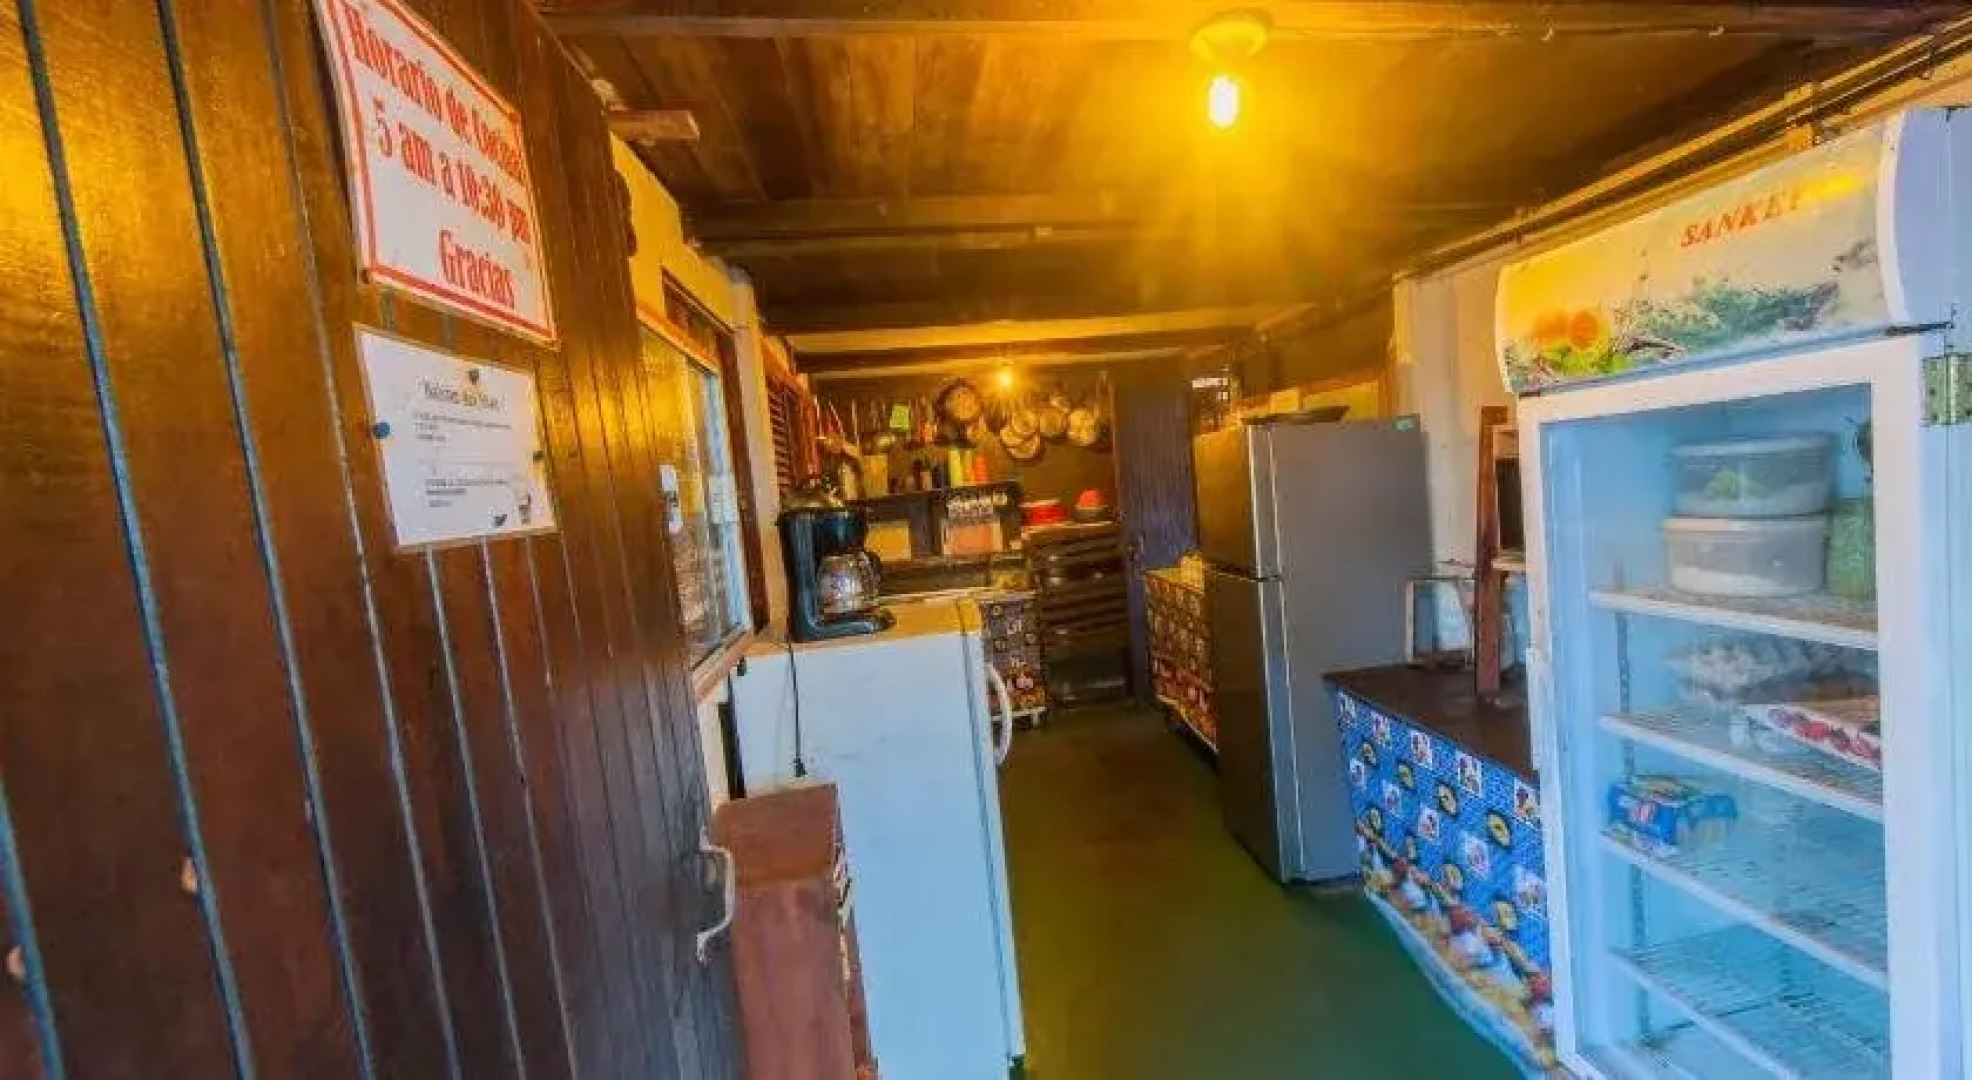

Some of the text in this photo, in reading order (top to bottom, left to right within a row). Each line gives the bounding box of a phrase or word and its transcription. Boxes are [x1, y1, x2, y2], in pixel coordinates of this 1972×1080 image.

[341, 0, 443, 124] Horario
[446, 87, 471, 144] de
[373, 94, 393, 158] 5
[398, 121, 437, 187] am
[438, 151, 456, 199] a
[438, 228, 515, 310] Gracias
